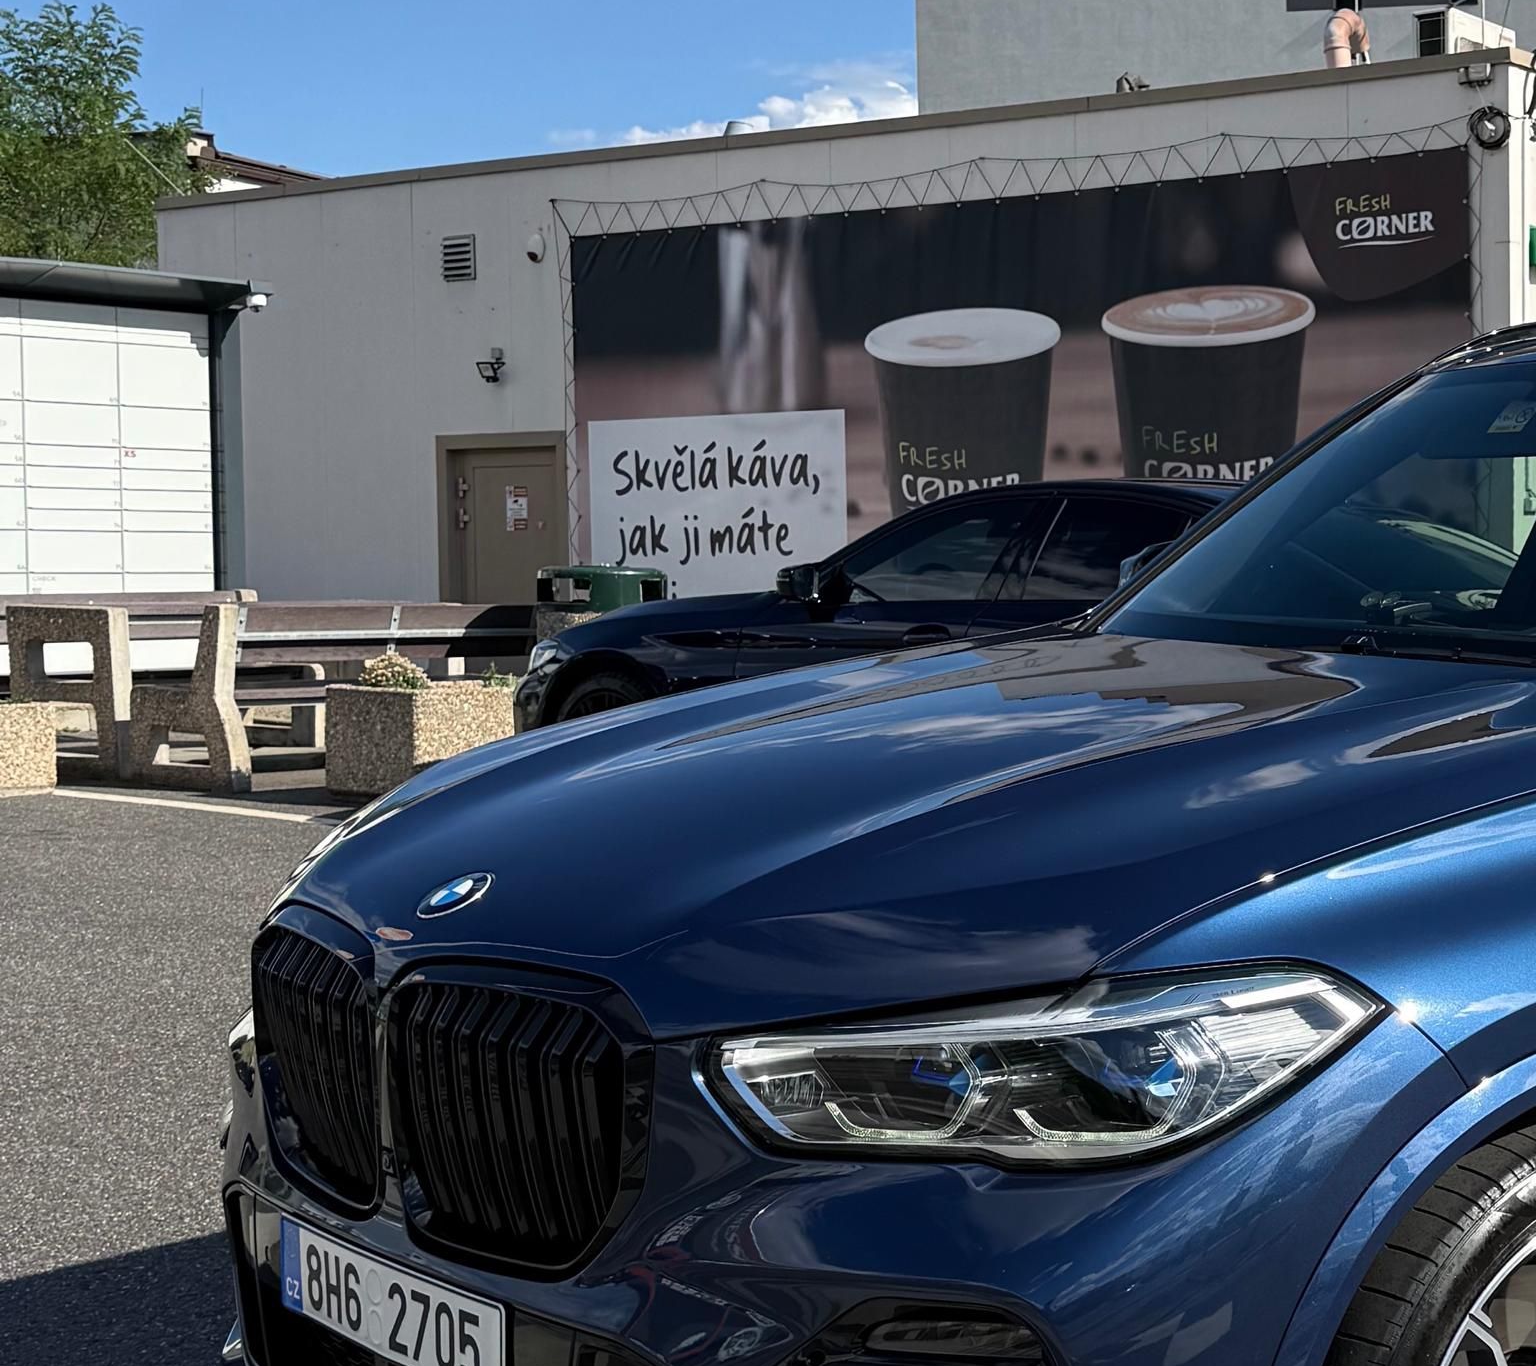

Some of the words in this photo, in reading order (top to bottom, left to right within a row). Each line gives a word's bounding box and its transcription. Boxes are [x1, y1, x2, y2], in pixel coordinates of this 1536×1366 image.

[1335, 193, 1391, 216] FRESH
[899, 441, 967, 470] FRESH
[1142, 425, 1218, 455] FRESH
[612, 441, 718, 496] Skvělá
[727, 439, 821, 495] káva,
[616, 515, 669, 566] jak
[679, 514, 701, 565] ji
[710, 506, 793, 556] máte
[286, 1276, 300, 1300] CZ
[306, 1243, 363, 1332] 8H6
